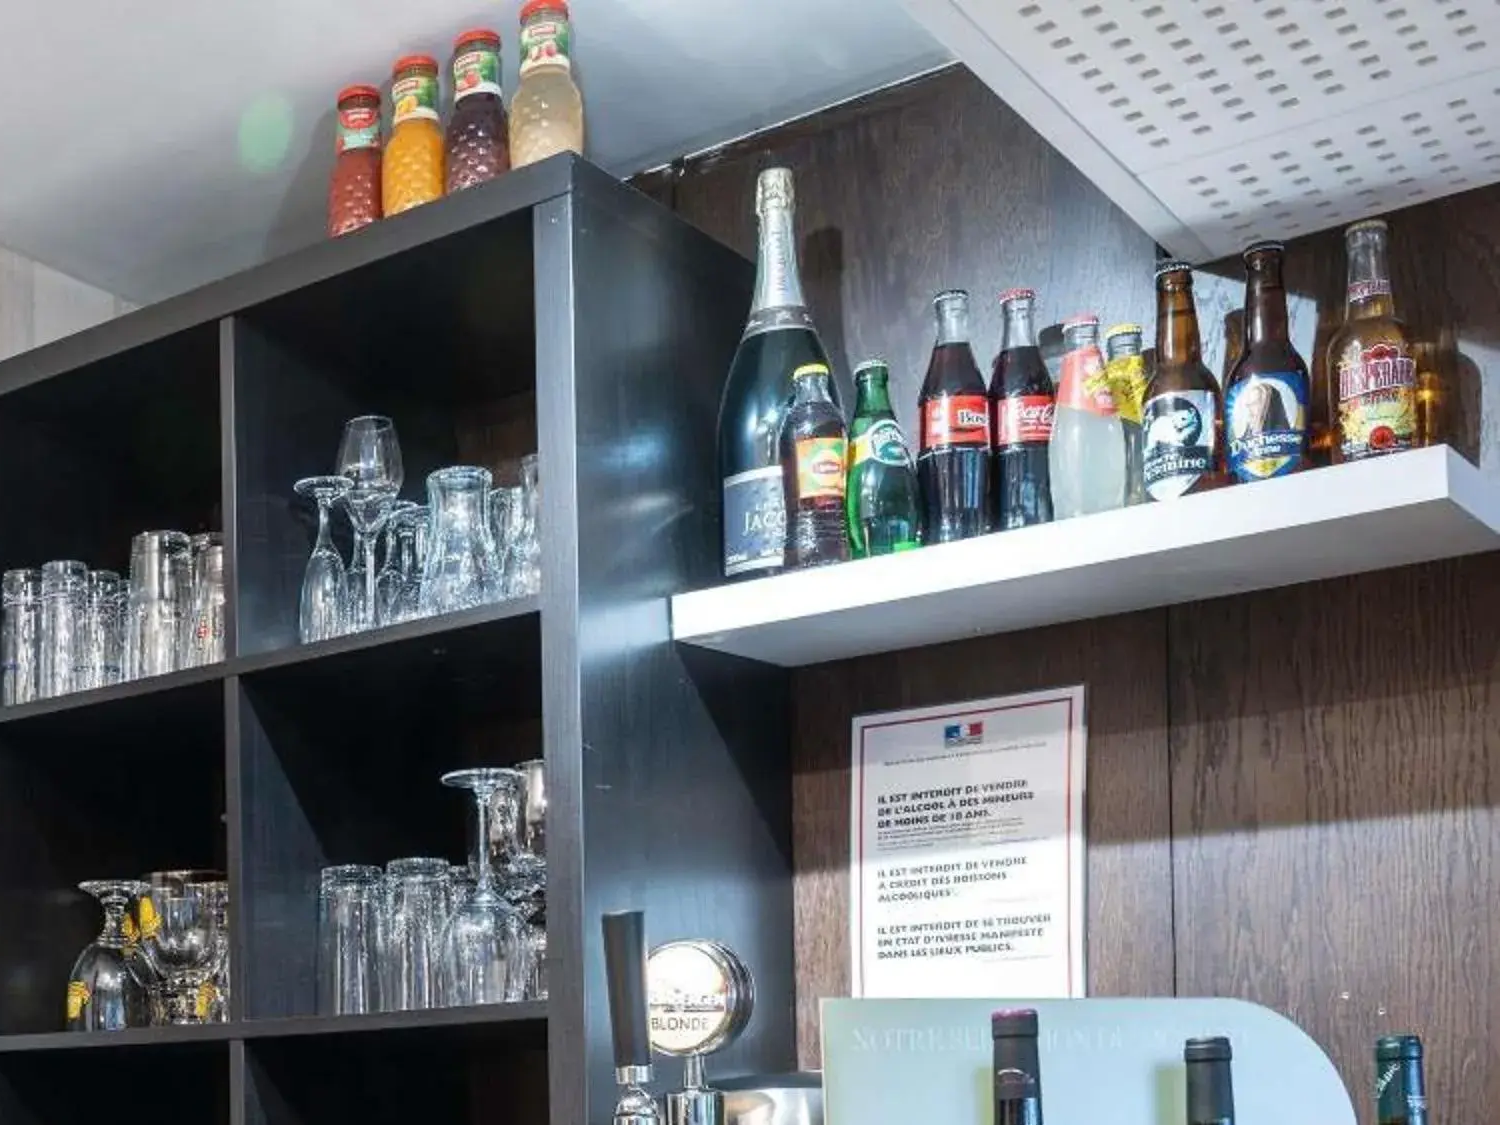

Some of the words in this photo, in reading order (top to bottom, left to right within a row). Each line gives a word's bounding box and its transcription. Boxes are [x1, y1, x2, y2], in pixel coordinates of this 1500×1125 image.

[878, 796, 886, 804] IL
[890, 793, 907, 803] EST
[911, 786, 962, 801] INTERDIT
[965, 785, 978, 794] DE
[878, 807, 891, 817] DE
[960, 796, 979, 807] DES
[878, 818, 891, 828] DE
[895, 815, 929, 826] MOINS
[932, 813, 946, 823] DE
[890, 867, 907, 877] EST
[910, 861, 961, 875] INTERDIT
[651, 1017, 710, 1032] BLONDE
